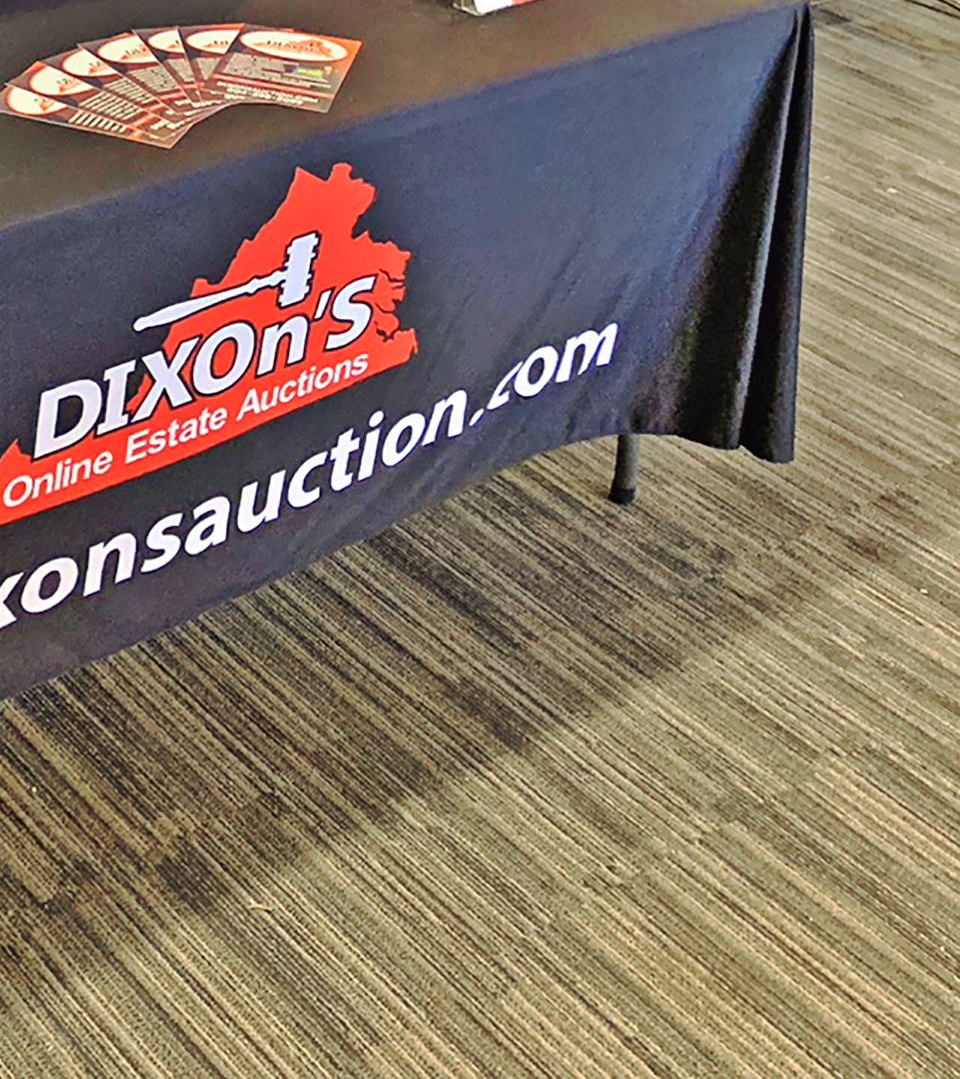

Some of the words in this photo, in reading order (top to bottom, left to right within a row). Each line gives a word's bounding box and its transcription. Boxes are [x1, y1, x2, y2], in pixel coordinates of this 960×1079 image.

[3, 449, 113, 509] Online
[124, 407, 228, 465] Estate
[237, 353, 369, 421] Auctions
[32, 275, 376, 459] DIXOn'S
